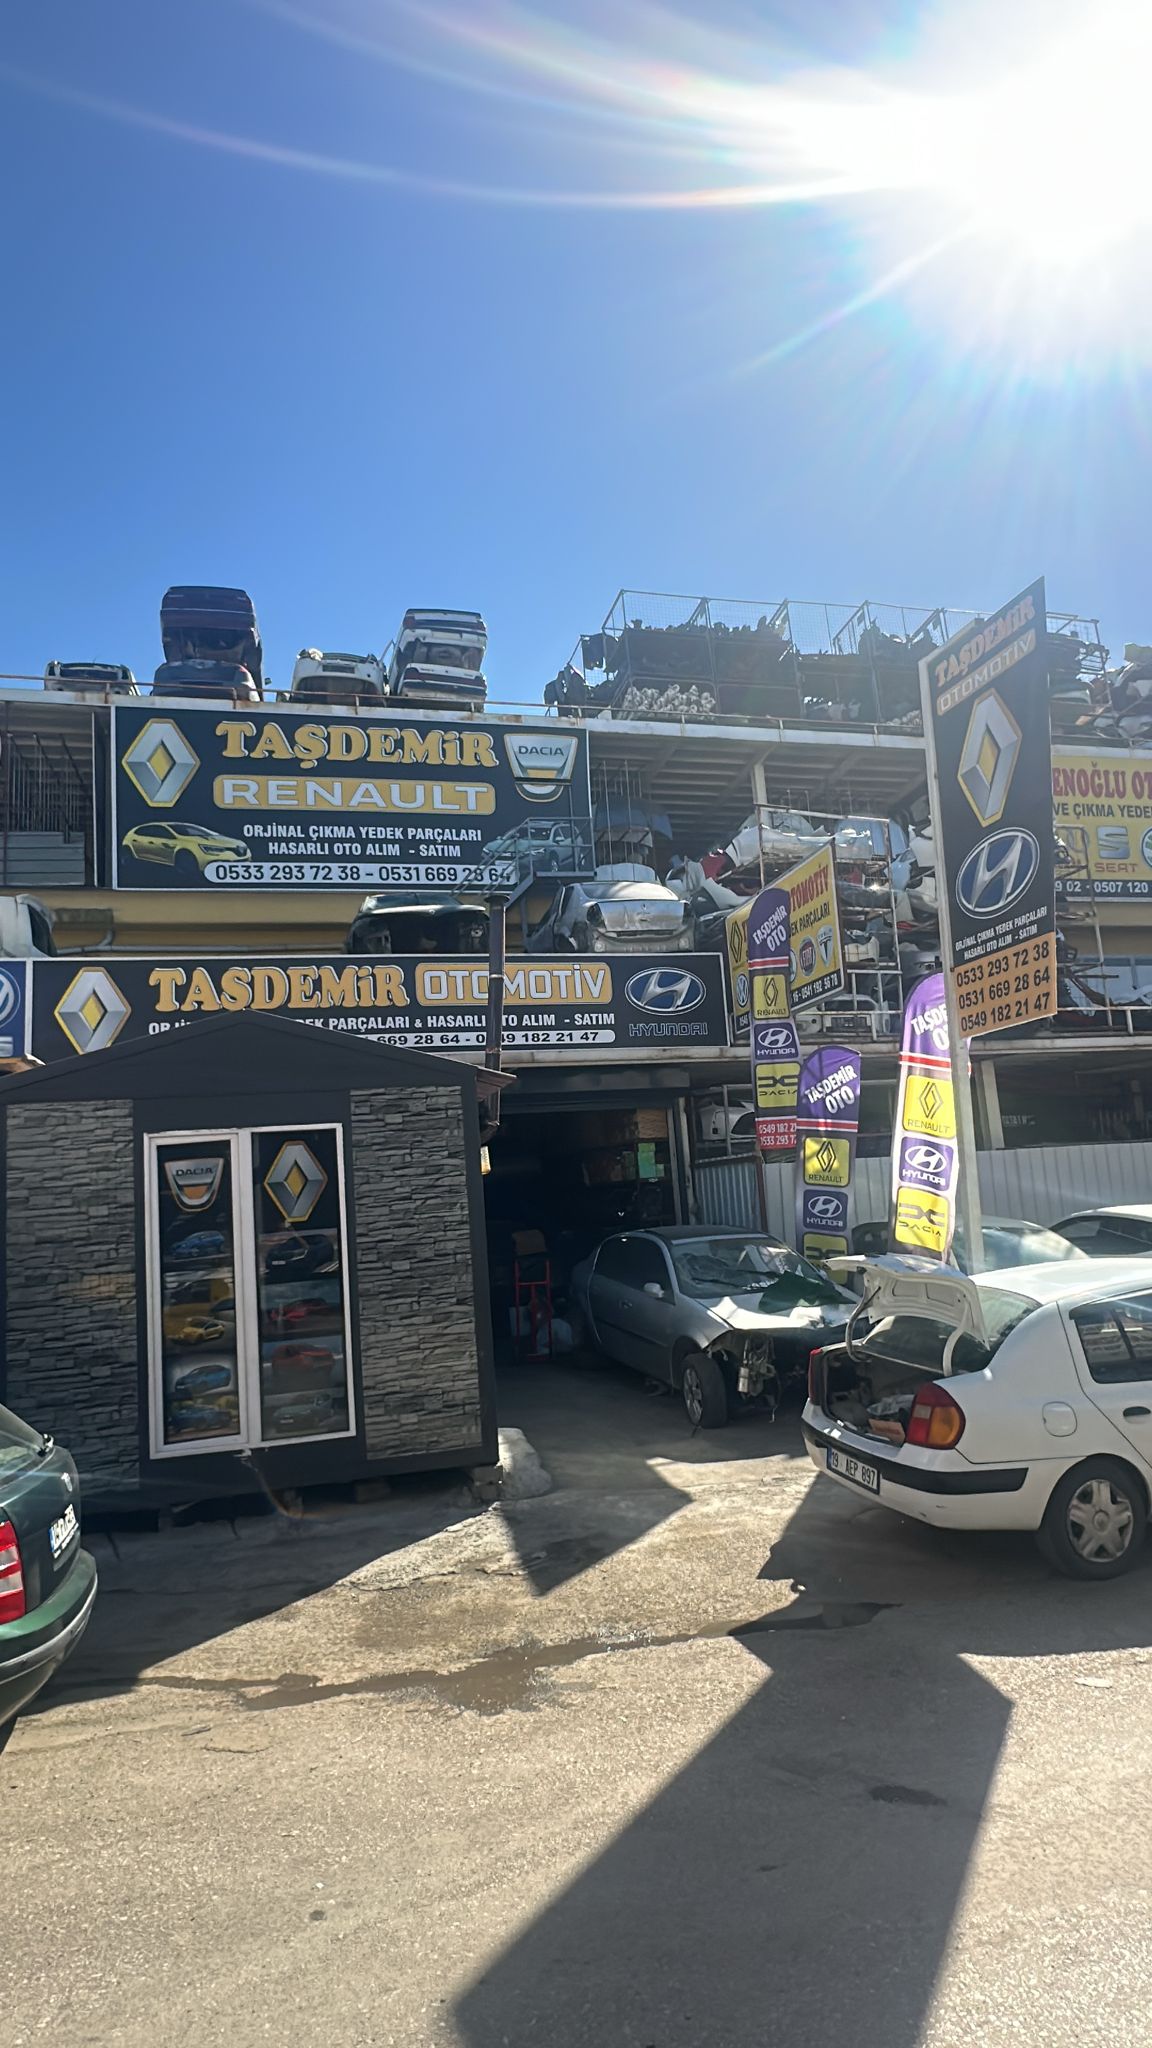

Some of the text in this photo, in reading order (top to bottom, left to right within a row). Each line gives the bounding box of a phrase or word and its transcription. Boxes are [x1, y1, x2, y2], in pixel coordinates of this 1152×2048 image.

[518, 745, 564, 756] DACIA
[1052, 761, 1152, 800] ENOĞLU OT
[222, 779, 488, 811] RENAULT
[1053, 803, 1152, 819] VE ÇIKMA YEDE
[243, 822, 482, 844] ORJİNAL ÇIKMA YEDEK PARÇALARI
[268, 842, 329, 855] HASARLI
[333, 843, 361, 856] OTO
[366, 844, 400, 857] ALIM
[419, 845, 461, 858] SATIM
[215, 864, 264, 881] 0533
[270, 865, 305, 881] 293
[310, 866, 333, 881] 72
[338, 866, 361, 881] 38
[379, 866, 420, 882] 0531
[425, 867, 458, 882] 669
[462, 867, 484, 882] 28
[1094, 862, 1138, 873] SEAT
[790, 864, 828, 912] TOMOTİV
[1066, 881, 1082, 892] 02
[1094, 881, 1123, 893] 0507
[1127, 881, 1149, 893] 120
[976, 928, 995, 944] ÇIKMA
[995, 920, 1013, 935] YEDEK
[1014, 906, 1047, 928] PARÇALARI
[766, 925, 787, 952] OTO
[964, 945, 986, 960] HASARLI
[986, 940, 997, 951] OTO
[998, 934, 1012, 945] ALIM
[1018, 924, 1038, 939] SATIM
[956, 941, 1050, 987] 0533 293 72 38
[423, 964, 606, 1000] OTOMOTİV
[958, 966, 1050, 1010] 0531 669 28 64
[757, 1008, 786, 1016] RENAULT
[911, 1003, 948, 1036] TAŞDE
[961, 992, 1050, 1031] 0549 182 21 47
[329, 1016, 410, 1032] PARÇALARI
[414, 1019, 423, 1028] &
[427, 1015, 486, 1028] HASARLI
[522, 1014, 555, 1026] ALIM
[574, 1013, 615, 1026] SATIM
[629, 1022, 708, 1037] HYUNDAI
[414, 1034, 434, 1045] 28
[440, 1034, 460, 1045] 64
[522, 1033, 551, 1043] 182
[556, 1032, 574, 1042] 21
[580, 1031, 599, 1042] 47
[757, 1047, 796, 1056] HYUNDAI
[825, 1085, 855, 1114] OTO
[908, 1118, 950, 1134] RENAULT
[776, 1134, 788, 1145] 293
[175, 1167, 214, 1177] DACIA
[808, 1174, 844, 1183] RENAULT
[902, 1169, 946, 1186] HYUNDAI
[806, 1217, 843, 1227] HYUNDAI
[898, 1220, 942, 1237] DACIA
[832, 1451, 839, 1468] 19
[845, 1458, 858, 1477] AEP
